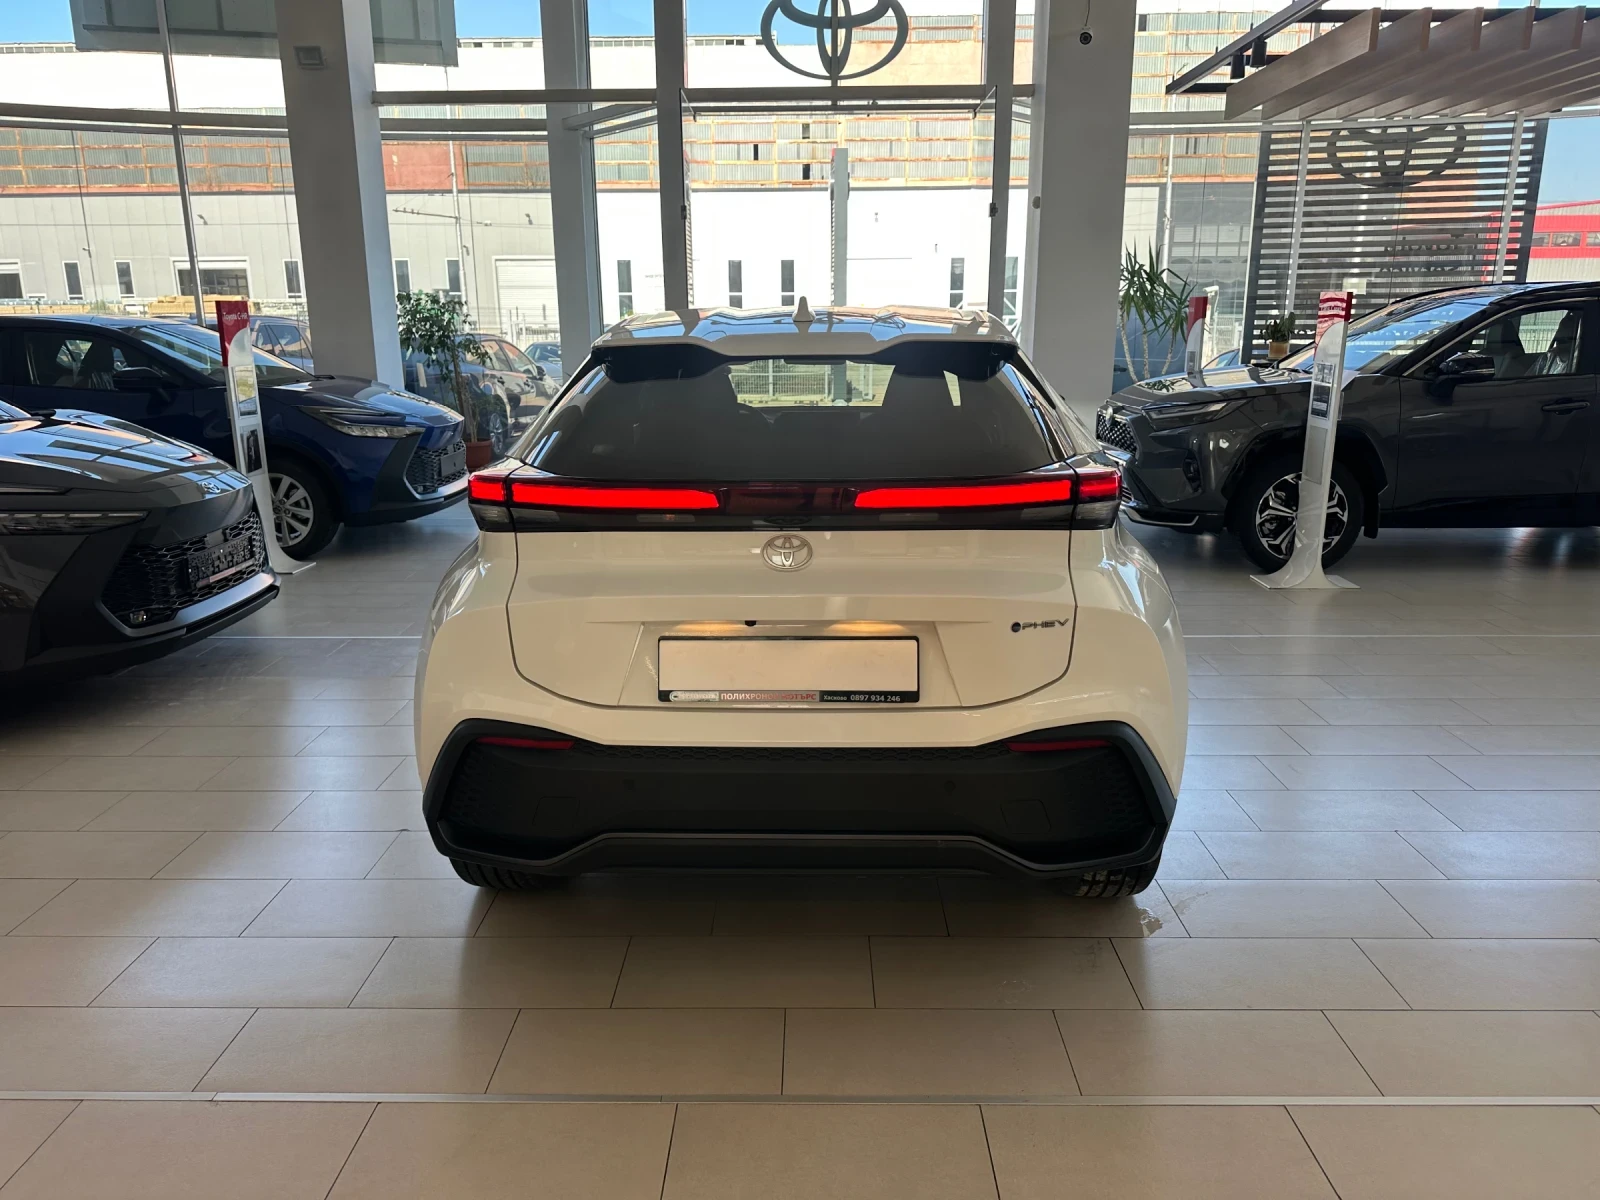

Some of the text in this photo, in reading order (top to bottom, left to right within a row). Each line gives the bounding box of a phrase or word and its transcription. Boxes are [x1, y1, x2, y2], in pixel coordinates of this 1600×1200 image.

[223, 312, 237, 321] Toyota
[1021, 618, 1070, 630] PHEV
[870, 694, 885, 702] 934
